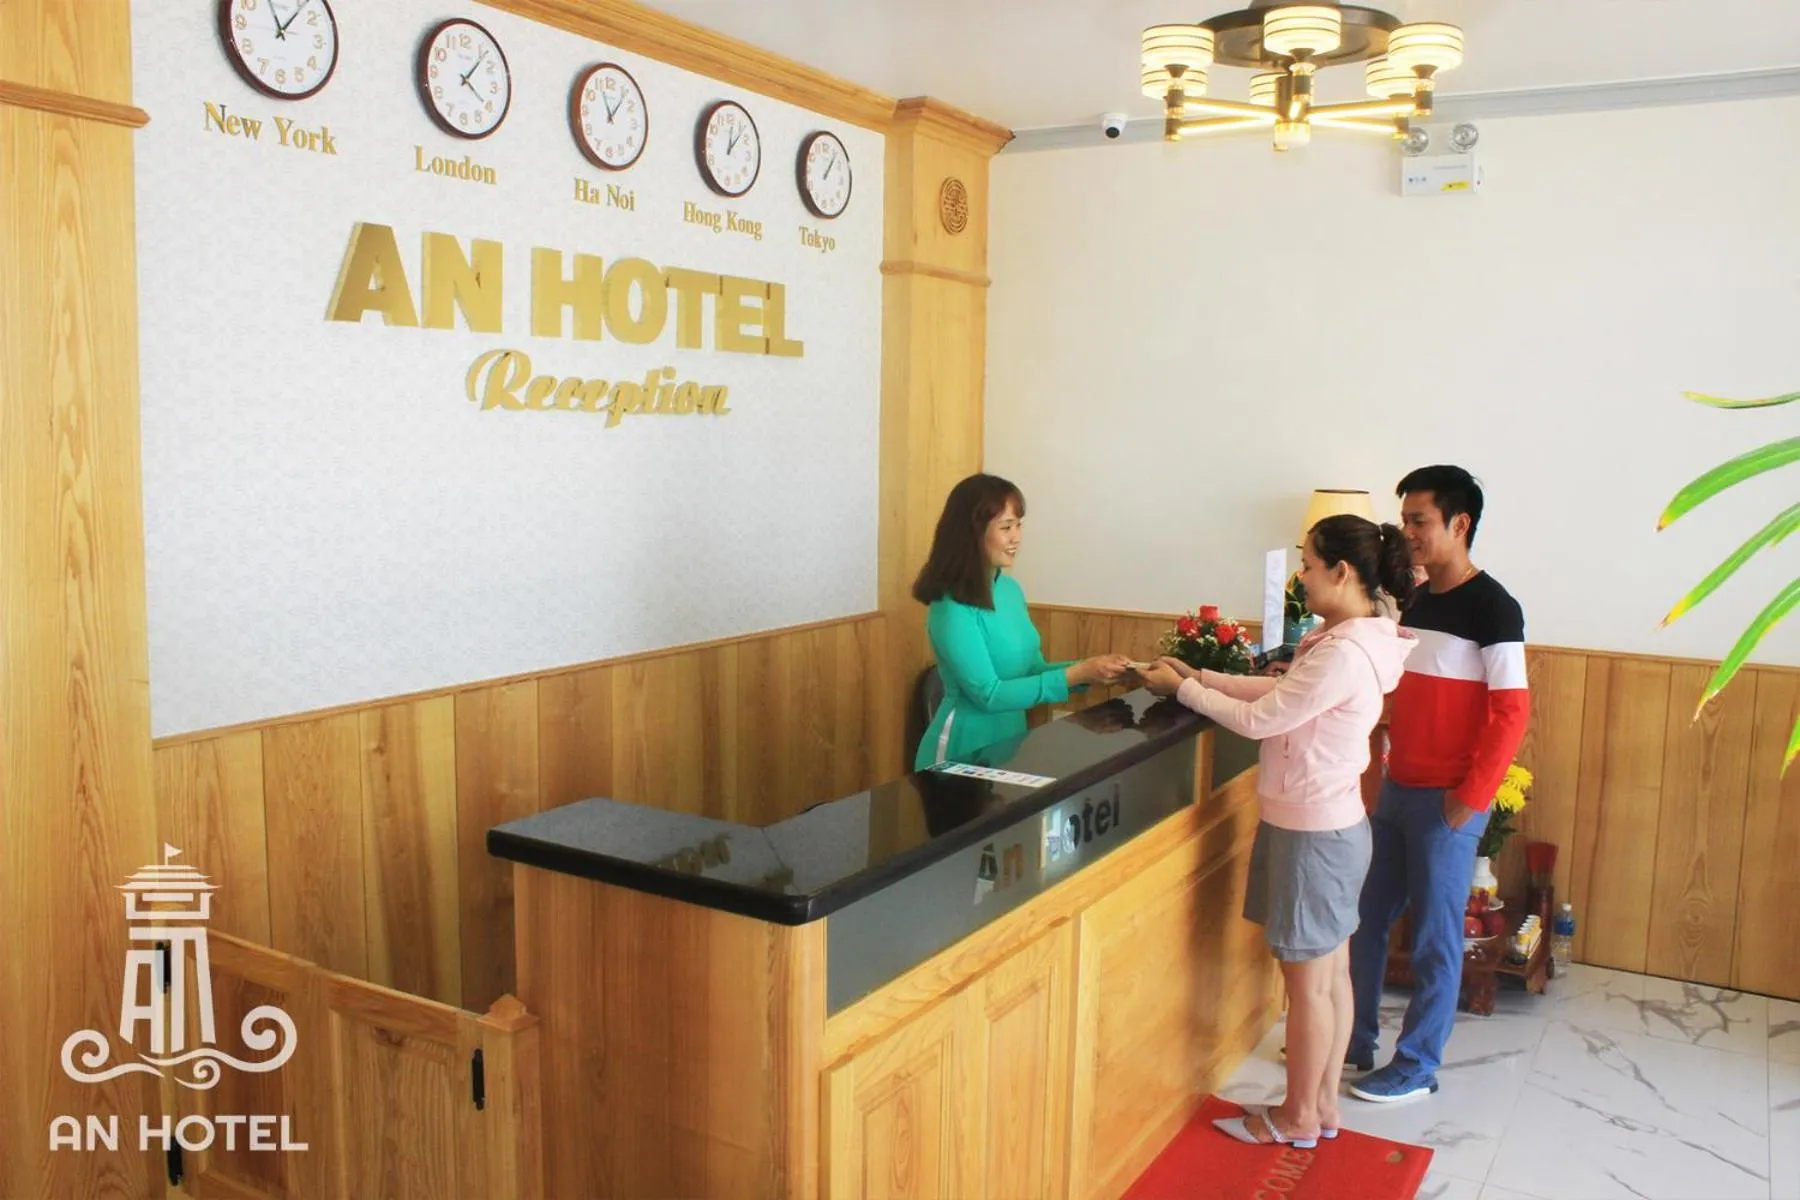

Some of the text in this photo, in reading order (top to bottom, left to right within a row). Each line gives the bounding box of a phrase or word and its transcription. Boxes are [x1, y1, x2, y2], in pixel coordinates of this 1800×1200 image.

[234, 13, 247, 30] 9
[307, 10, 317, 26] 2
[242, 38, 254, 54] 8
[313, 34, 323, 50] 3
[445, 34, 456, 50] 11
[459, 33, 472, 49] 12
[434, 45, 447, 62] 10
[257, 57, 269, 75] 7
[307, 55, 317, 70] 4
[485, 60, 495, 74] 2
[274, 68, 286, 85] 6
[293, 66, 305, 83] 5
[490, 81, 497, 94] 3
[445, 101, 455, 117] 7
[202, 99, 338, 156] New York
[414, 145, 498, 185] London
[574, 177, 636, 211] Ha Noi
[683, 201, 763, 241] Hong Kong
[799, 225, 836, 254] Tokyo
[323, 220, 804, 359] AN HOTEL
[465, 348, 731, 429] Reception
